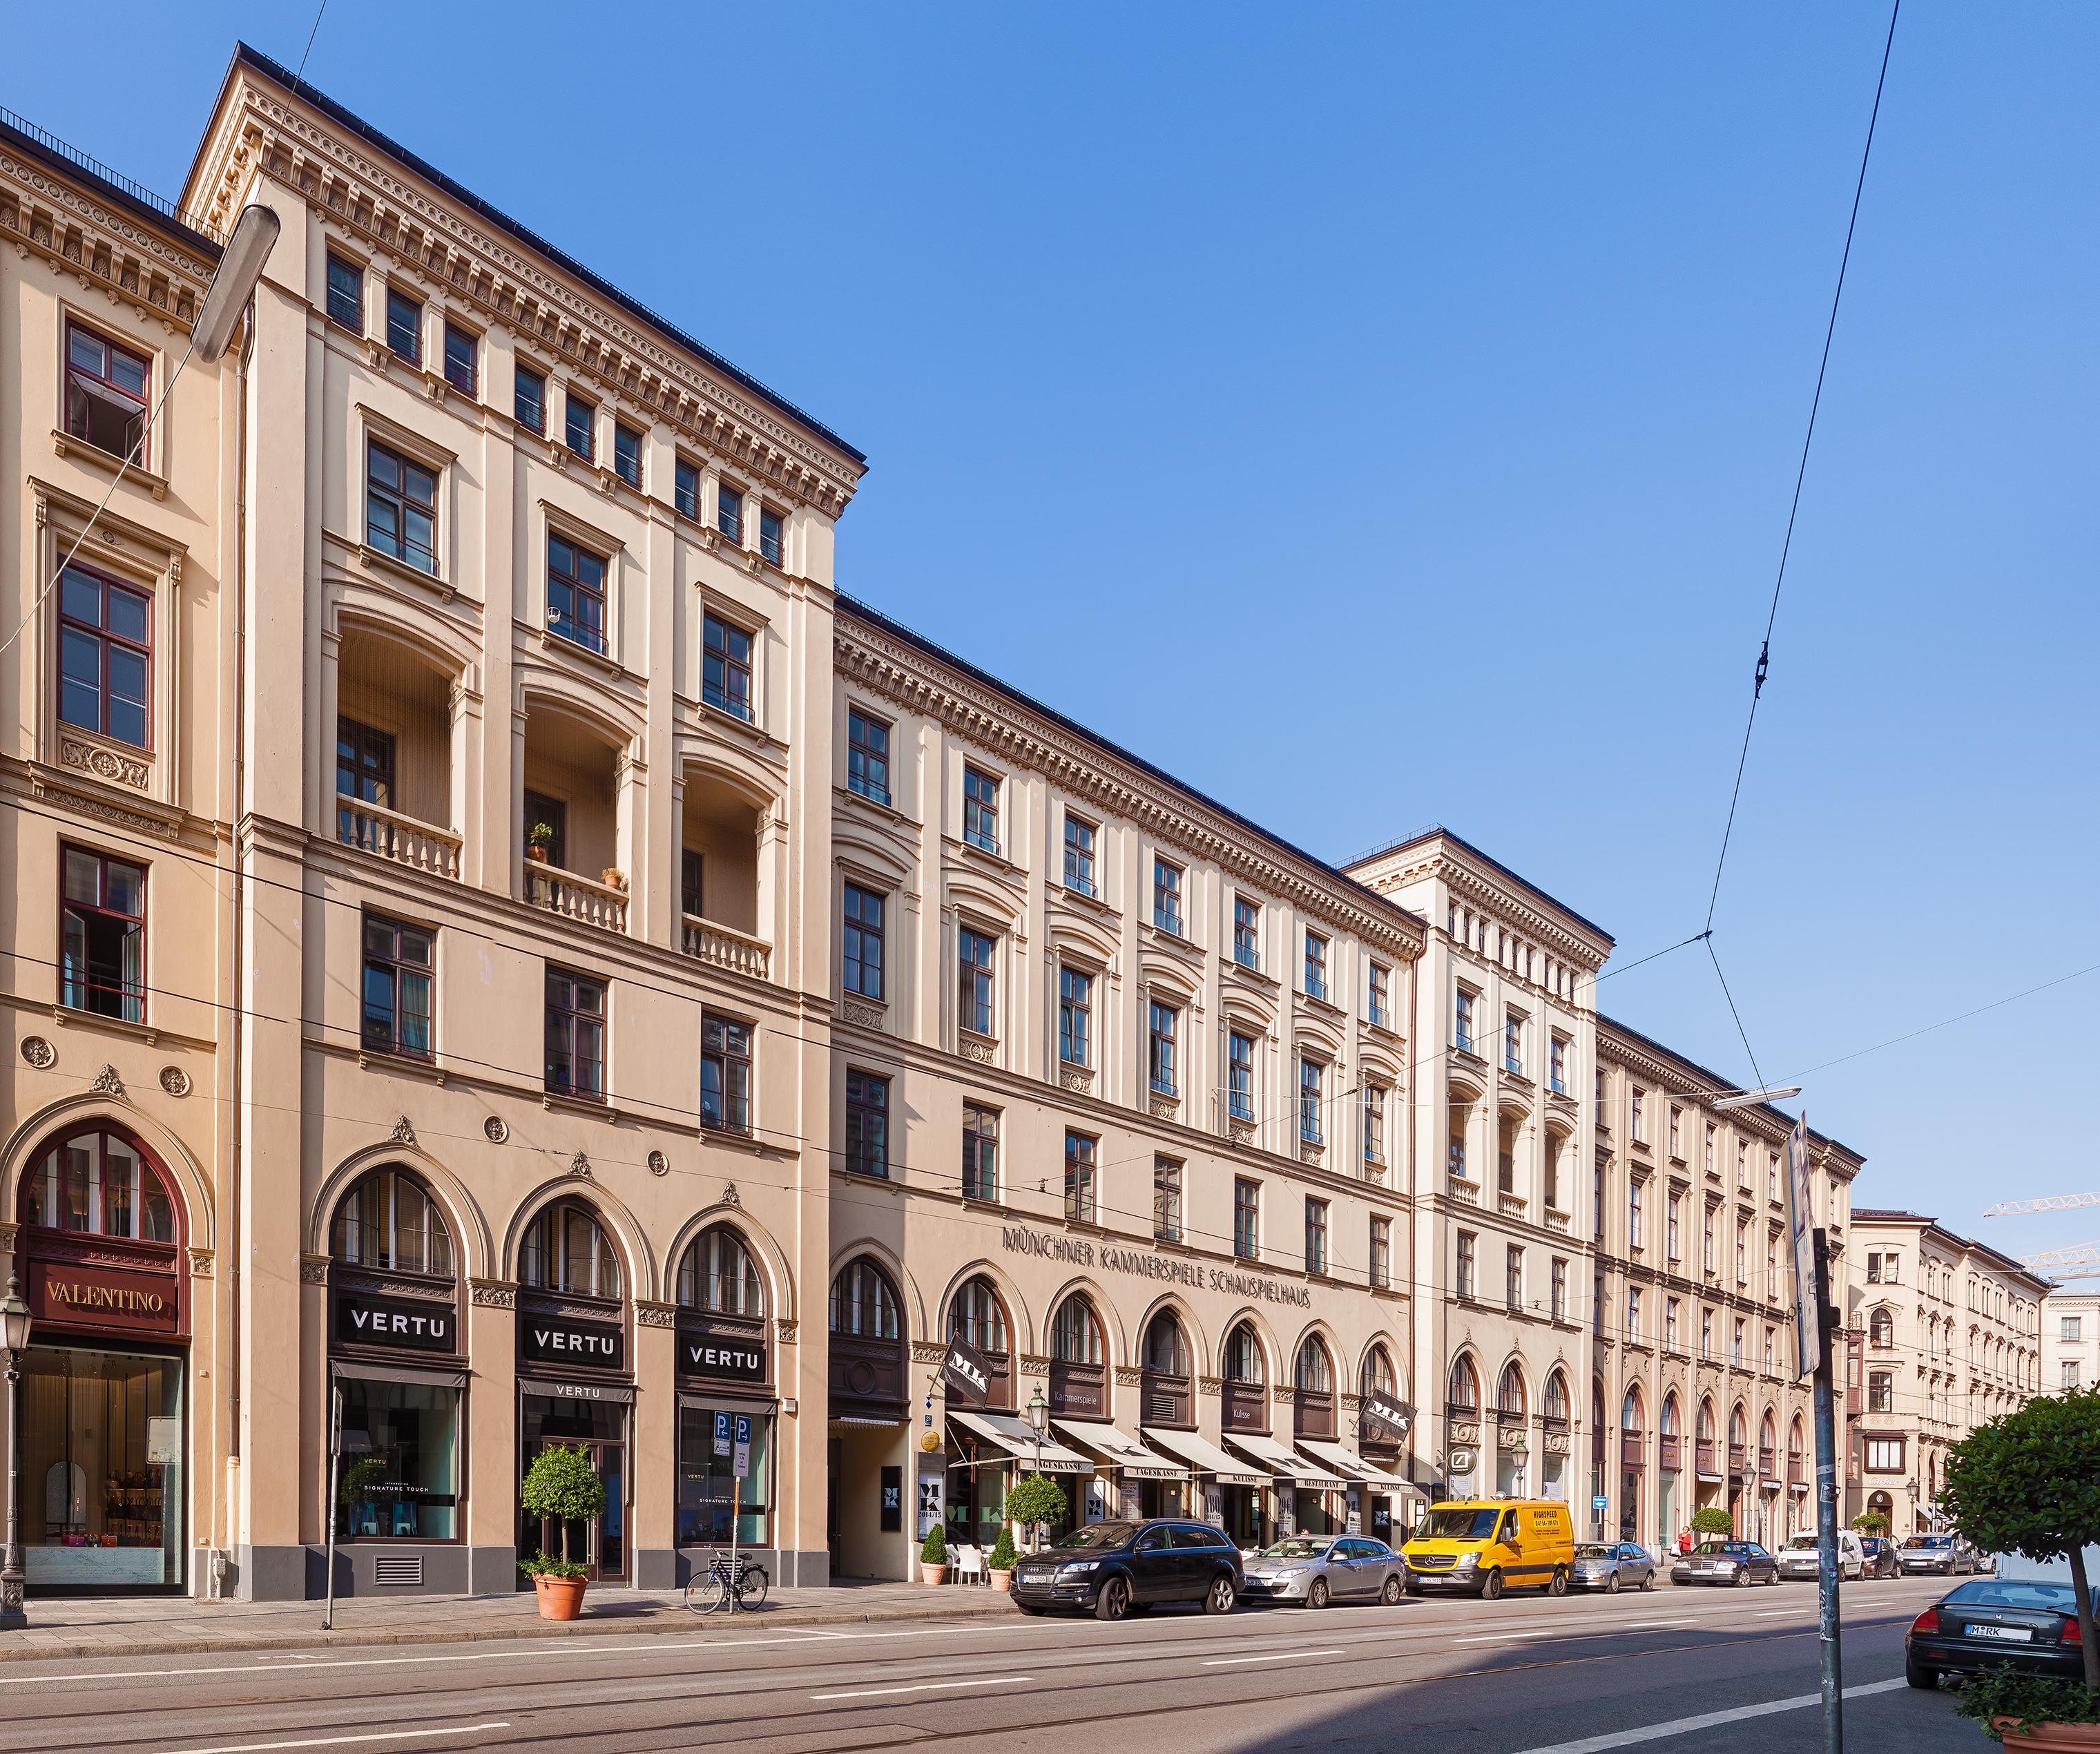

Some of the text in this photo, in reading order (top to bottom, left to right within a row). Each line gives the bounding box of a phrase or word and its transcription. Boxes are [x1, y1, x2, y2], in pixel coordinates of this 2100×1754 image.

[1002, 1225, 1310, 1309] MÜNCHNER KAMMERSPIELE SCHAUSPIELHAUS
[46, 1281, 163, 1312] VALENTINO
[351, 1309, 444, 1338] VERTU
[534, 1330, 614, 1354] VERTU
[690, 1347, 758, 1369] VERTU
[950, 1351, 988, 1390] MK
[556, 1385, 599, 1398] VERTU
[1054, 1391, 1097, 1406] Kammerspiele
[1233, 1409, 1250, 1419] Kulisse
[1370, 1400, 1410, 1428] MK
[1135, 1468, 1178, 1477] TAGESKASSE
[1233, 1474, 1258, 1483] KULISSE
[1304, 1480, 1339, 1488] RESTAURANT
[1205, 1494, 1220, 1513] ABO
[1533, 1510, 1557, 1519] HIGHSPEED
[1972, 1626, 2001, 1637] M RK
